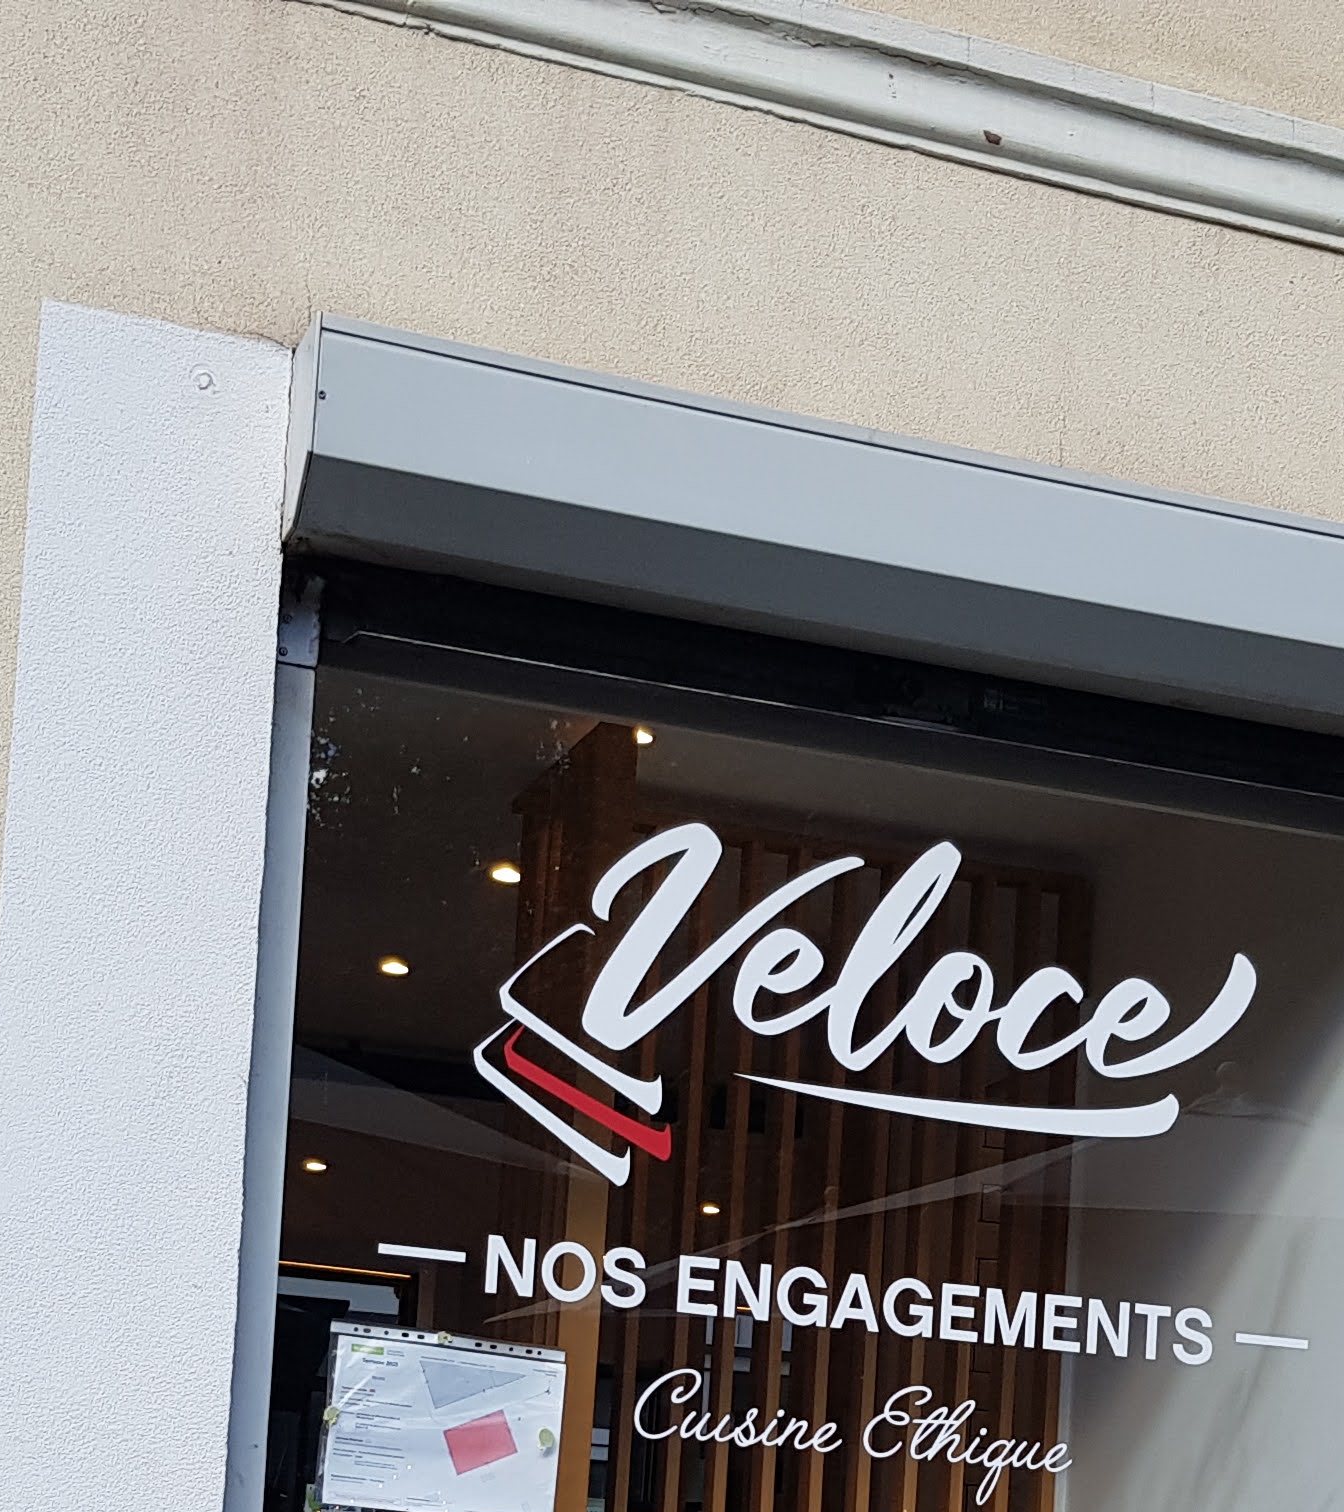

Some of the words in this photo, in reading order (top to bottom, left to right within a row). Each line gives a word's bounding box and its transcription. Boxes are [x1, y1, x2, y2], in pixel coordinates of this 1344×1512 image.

[581, 822, 1257, 1079] Veloce
[483, 1233, 647, 1309] NOS
[675, 1254, 1215, 1366] ENGAGEMENTS
[633, 1367, 844, 1453] Cuisine
[862, 1385, 1074, 1506] Ethique
